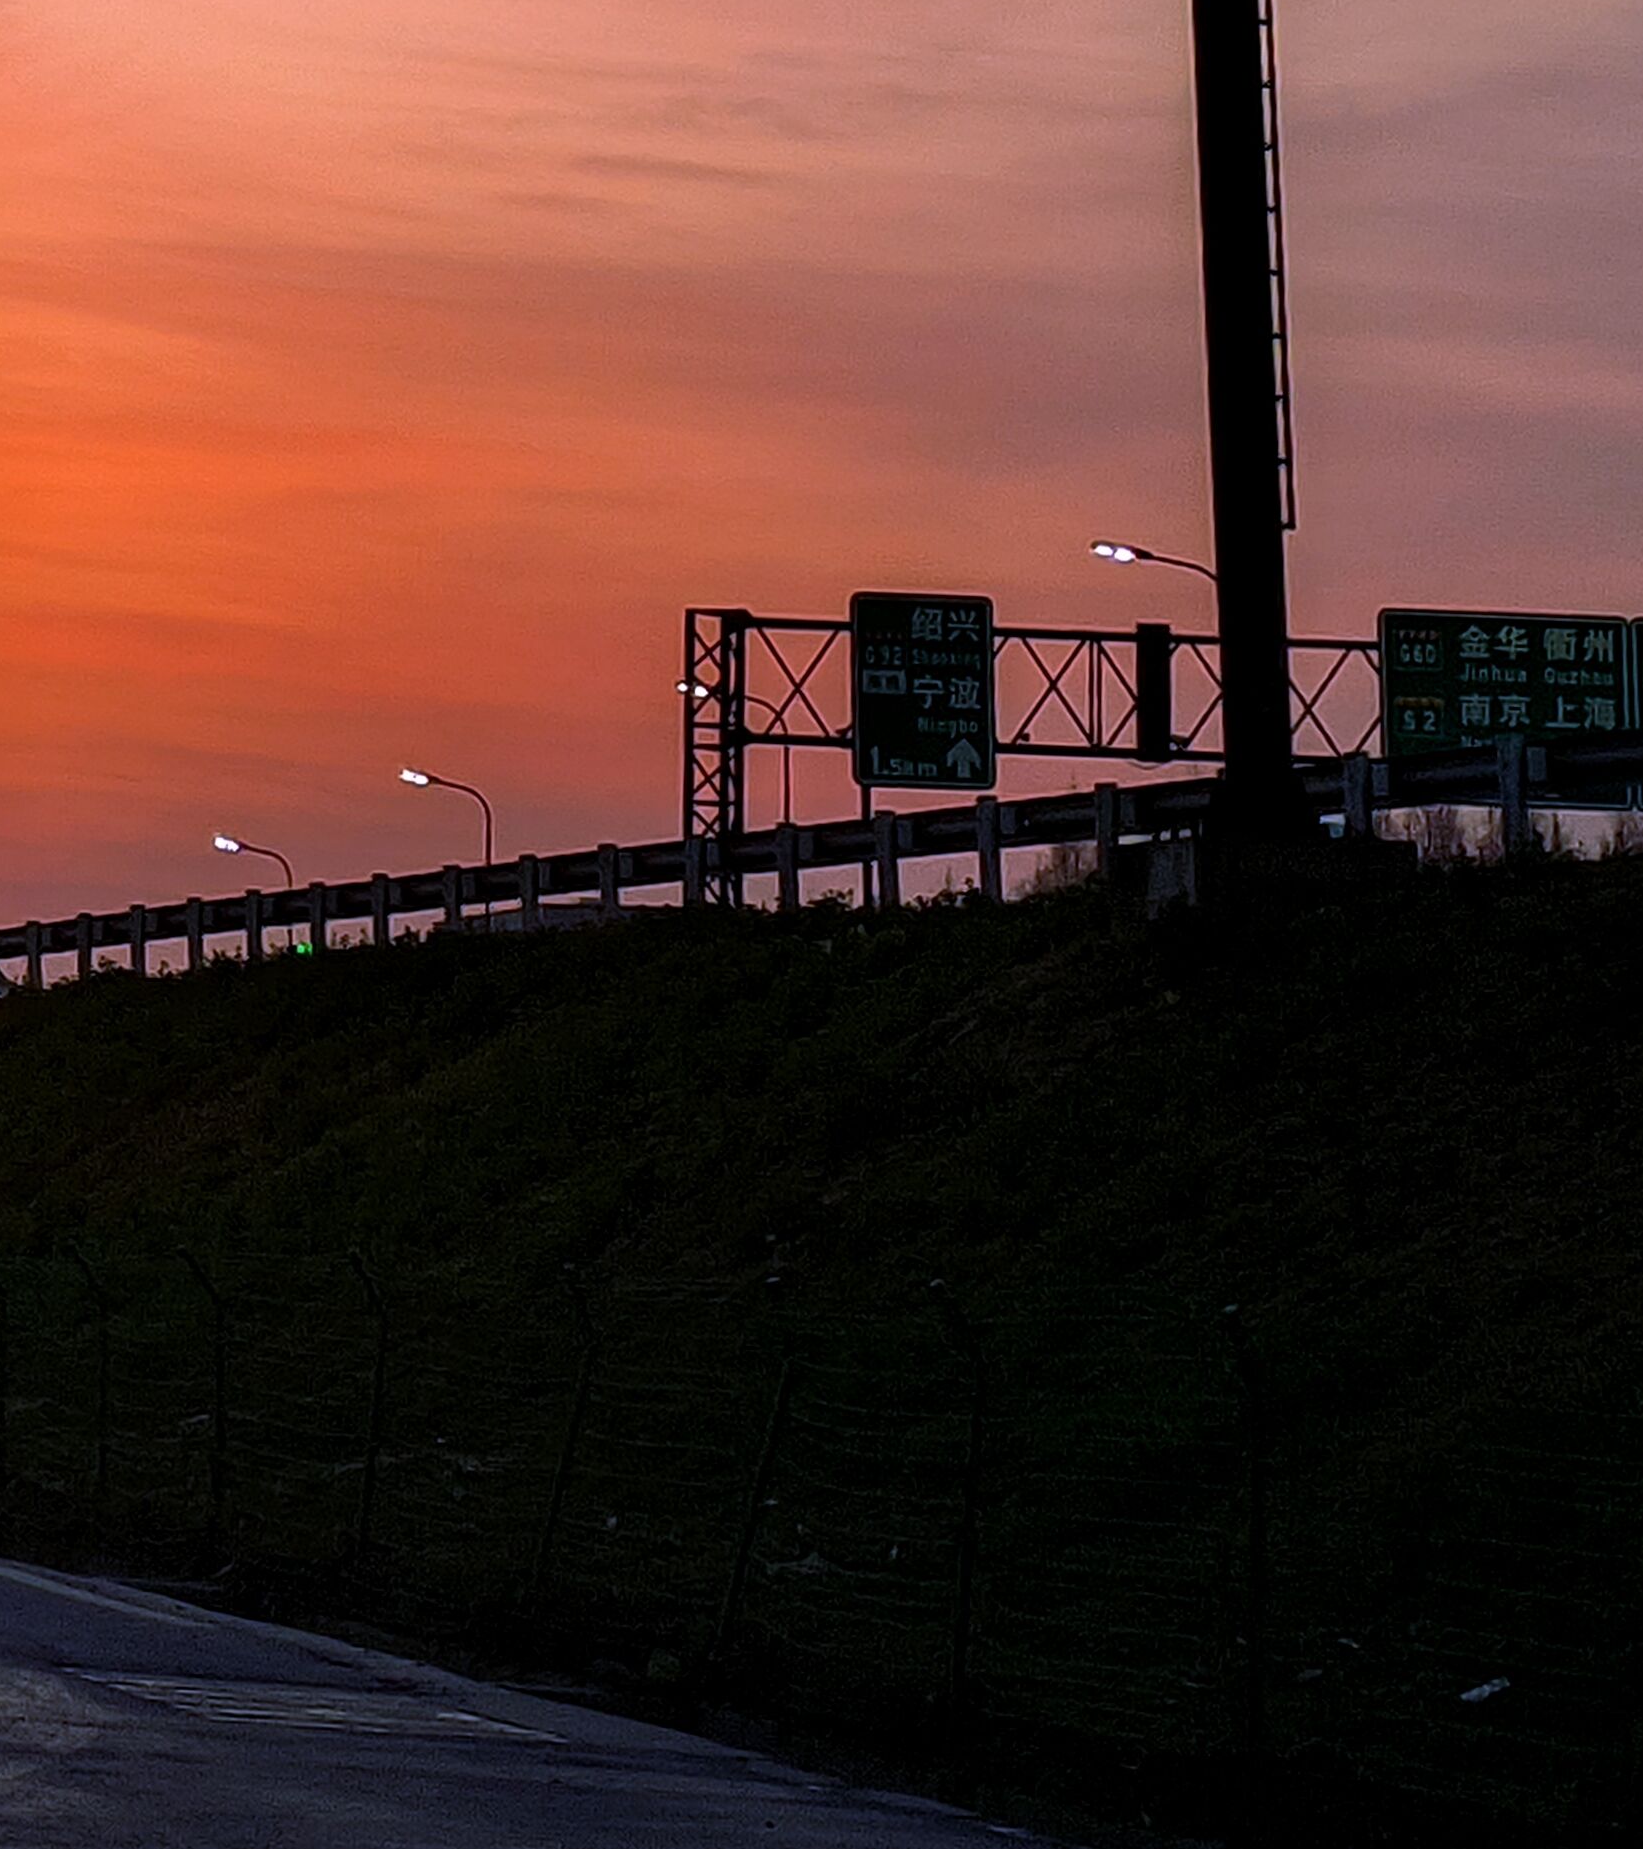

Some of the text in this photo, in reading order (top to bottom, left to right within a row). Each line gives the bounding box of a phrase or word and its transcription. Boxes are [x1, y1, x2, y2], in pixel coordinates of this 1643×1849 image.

[911, 606, 981, 641] 绍兴
[1399, 642, 1437, 664] G60
[1458, 623, 1615, 663] 金华 衢州
[865, 645, 903, 666] G92
[1459, 663, 1528, 683] Jinhua
[912, 674, 982, 710] 宁波
[1402, 709, 1437, 732] S2
[1458, 693, 1617, 730] 南京 上海
[917, 716, 979, 739] Ningbo
